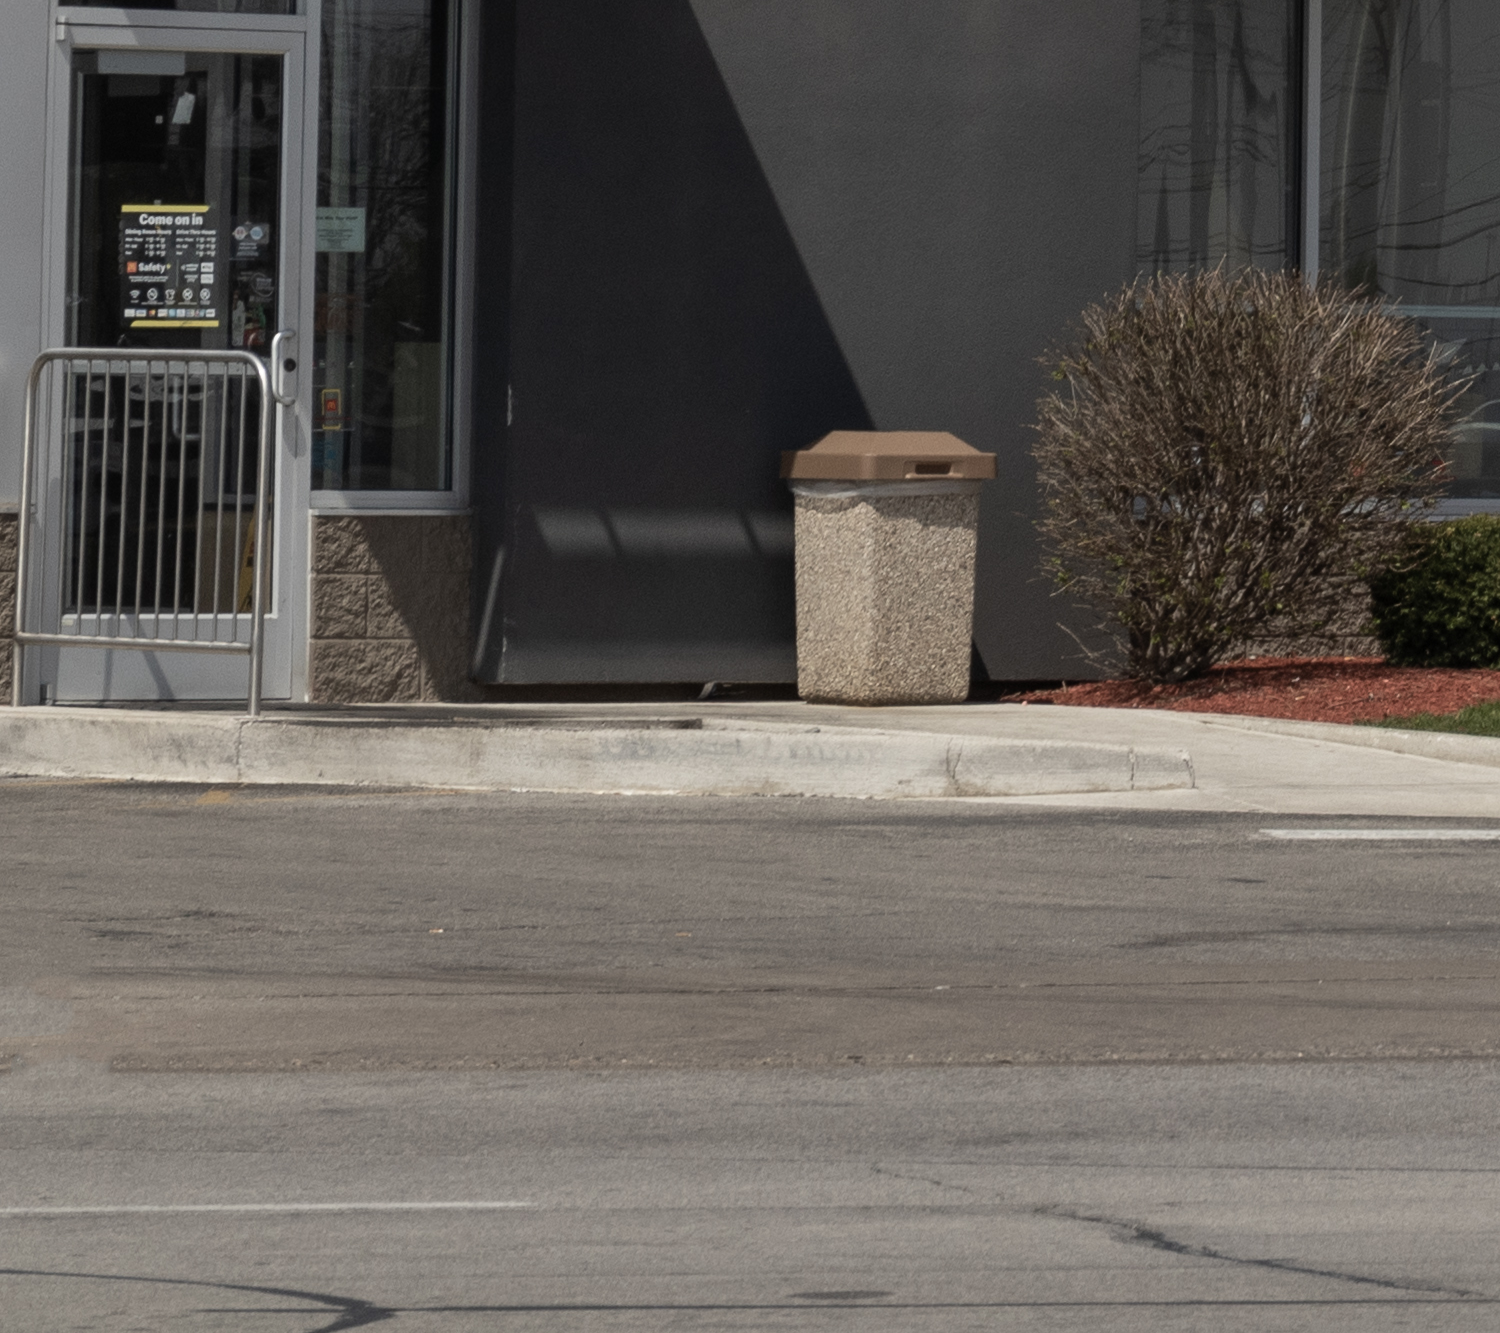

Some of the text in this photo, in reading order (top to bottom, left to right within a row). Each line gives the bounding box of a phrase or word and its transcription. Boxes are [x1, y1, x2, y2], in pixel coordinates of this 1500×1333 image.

[139, 212, 204, 225] Come on in
